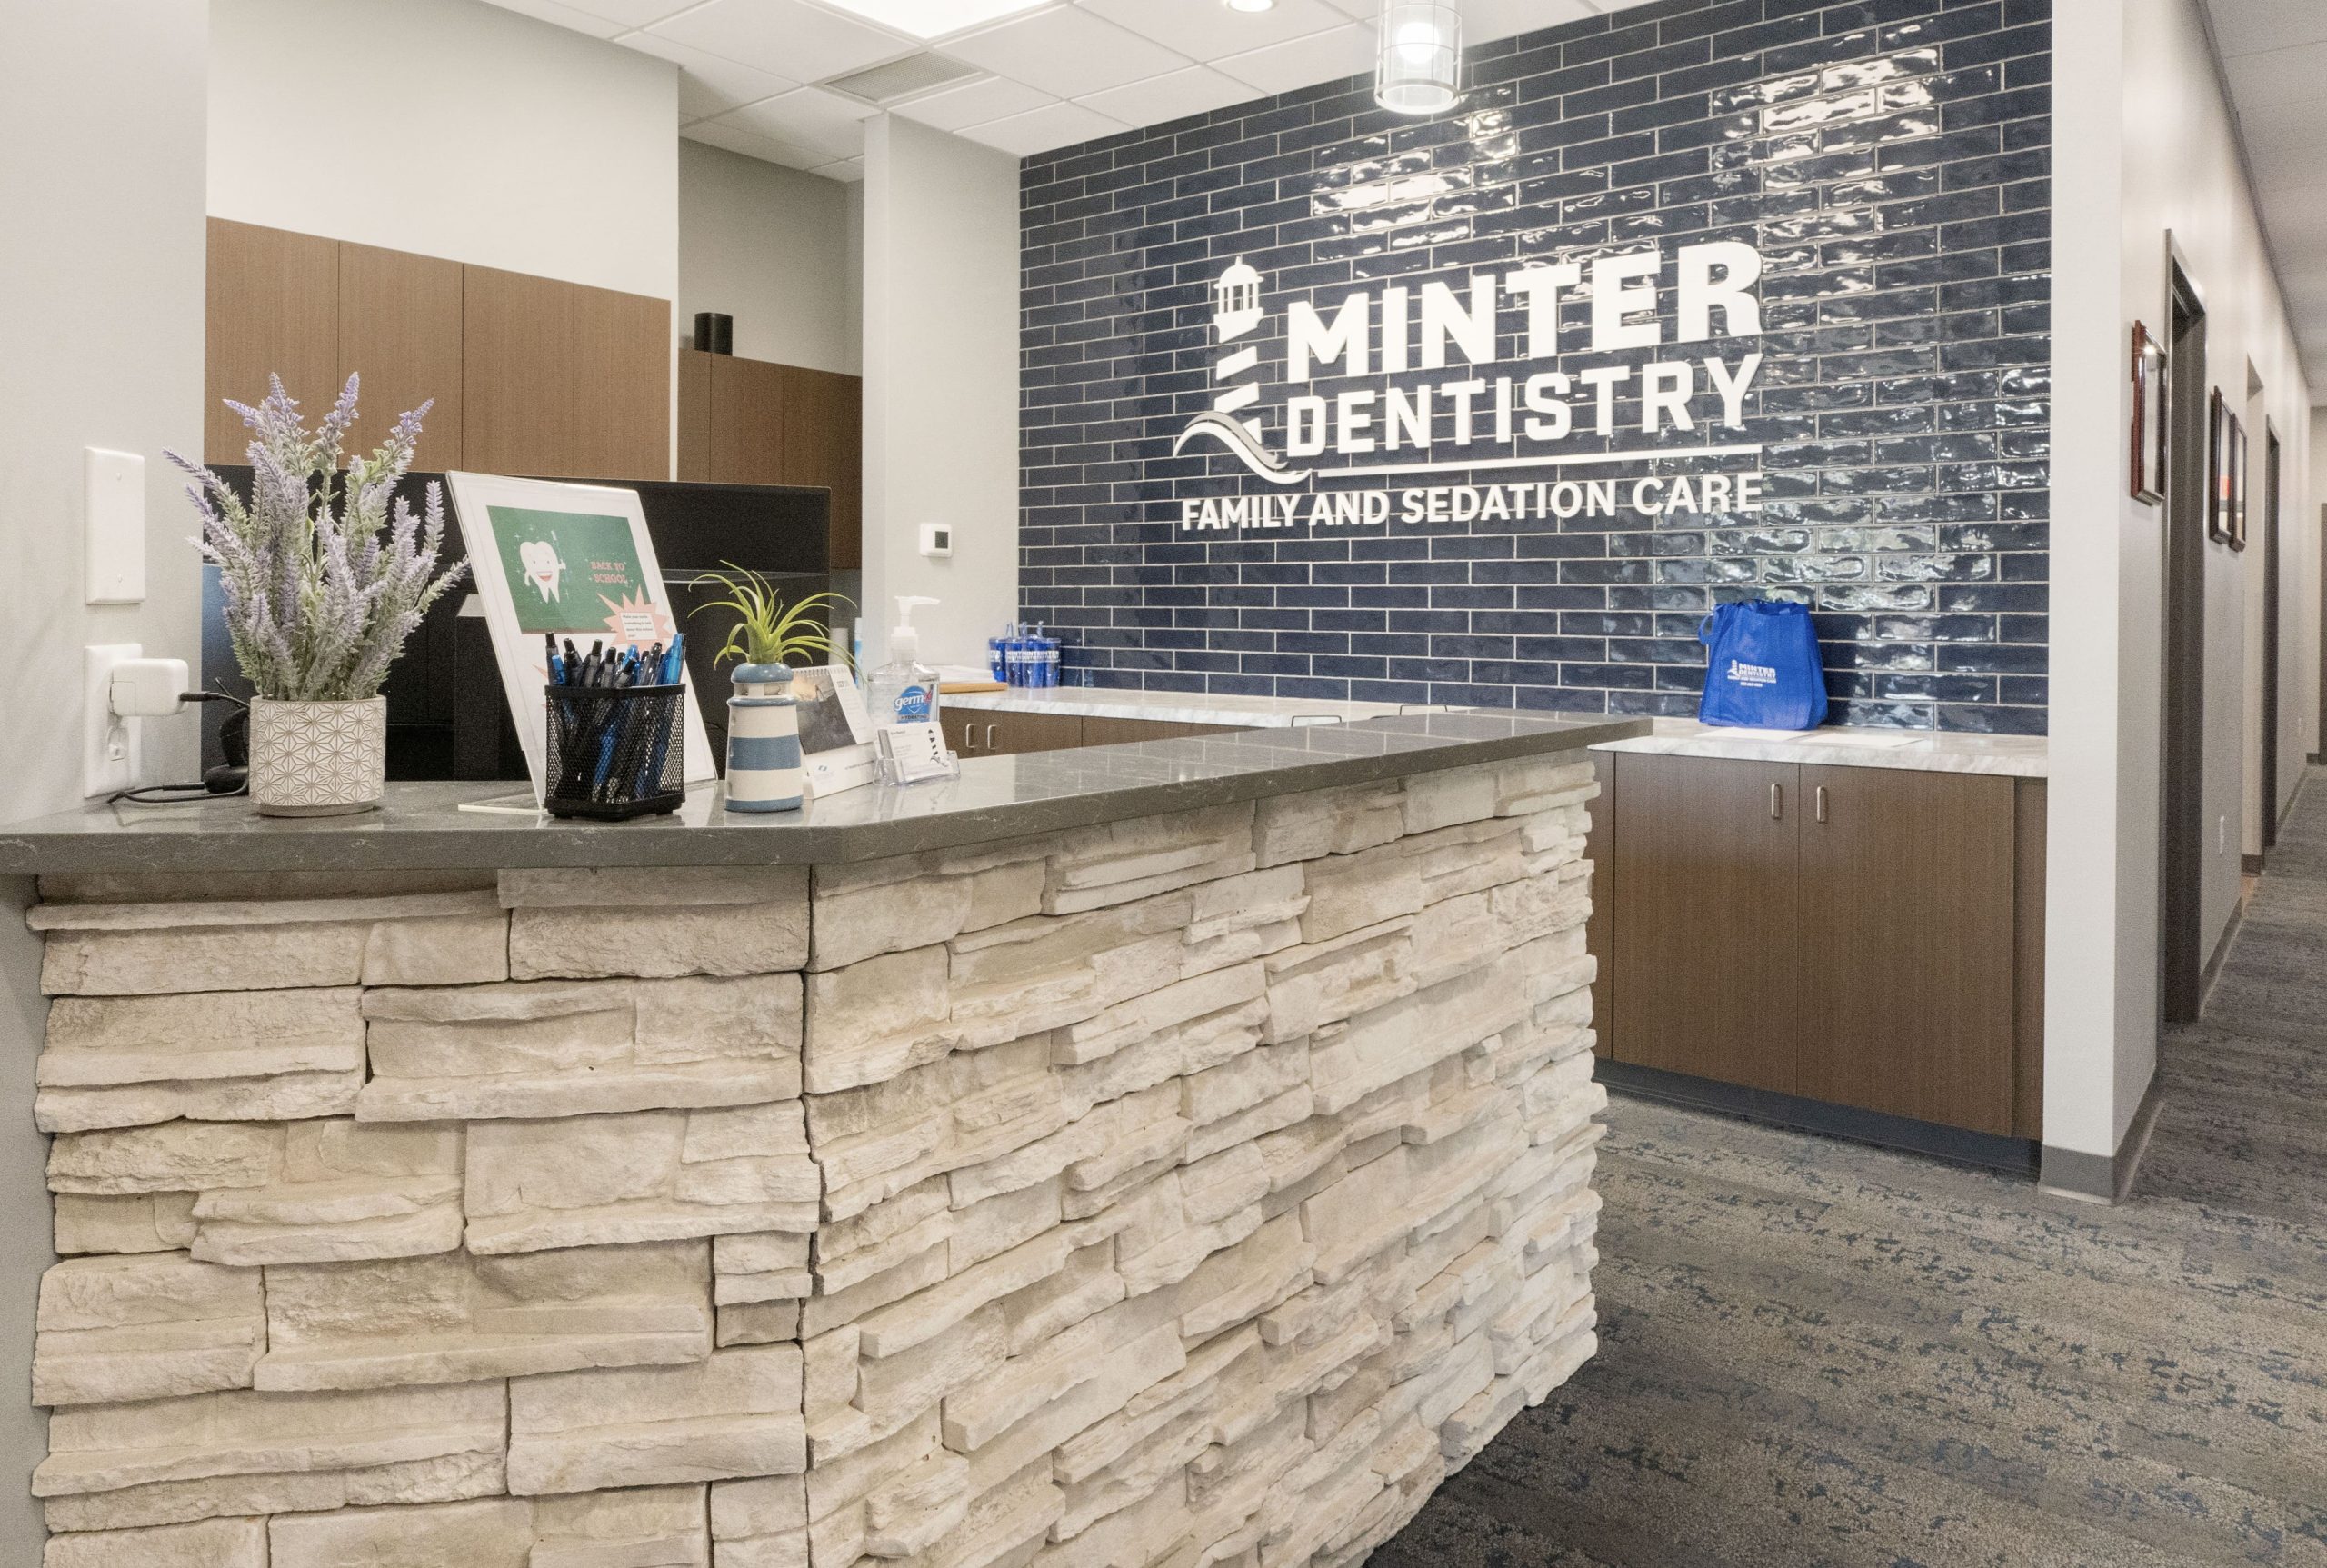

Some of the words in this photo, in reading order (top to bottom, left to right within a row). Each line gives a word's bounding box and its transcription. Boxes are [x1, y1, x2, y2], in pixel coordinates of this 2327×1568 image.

[1286, 240, 1763, 384] MINTER
[1286, 353, 1763, 457] DENTISTRY
[1182, 494, 1302, 531] FAMILY
[1308, 491, 1390, 526] AND
[1401, 479, 1616, 524] SEDATION
[1633, 473, 1763, 515] CARE
[590, 561, 613, 570] BACK
[613, 562, 624, 571] TO
[594, 573, 627, 584] SCHOOL
